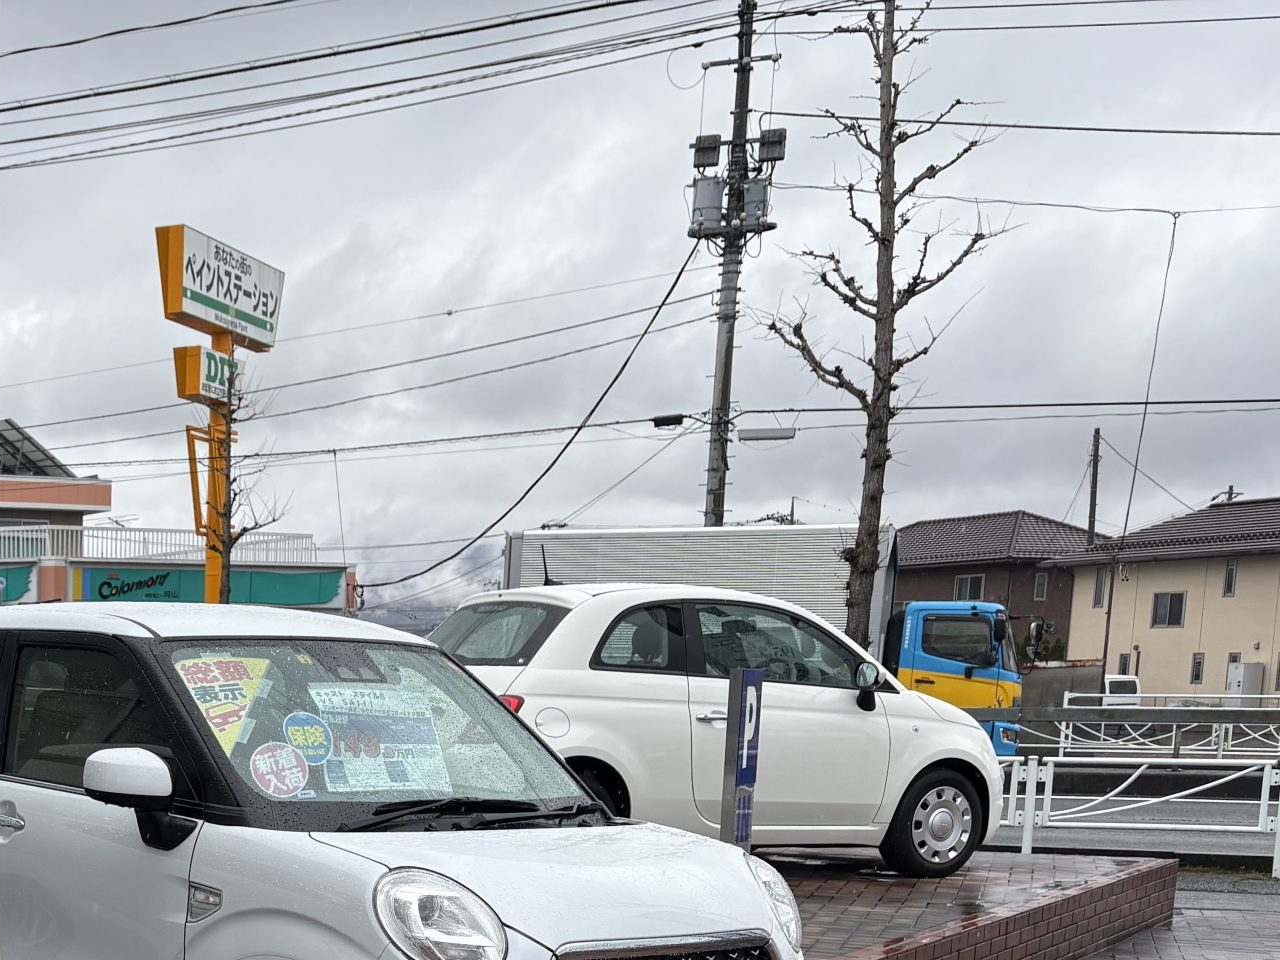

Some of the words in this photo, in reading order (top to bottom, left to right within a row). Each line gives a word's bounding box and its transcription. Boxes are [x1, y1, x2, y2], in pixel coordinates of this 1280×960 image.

[214, 244, 253, 277] あなたの街の
[185, 253, 278, 319] ペイントステーション
[179, 659, 255, 685] 総額
[191, 682, 248, 704] 表示
[287, 725, 328, 746] 保険
[742, 685, 758, 770] P
[253, 747, 298, 774] 新着
[265, 767, 305, 794] 入荷
